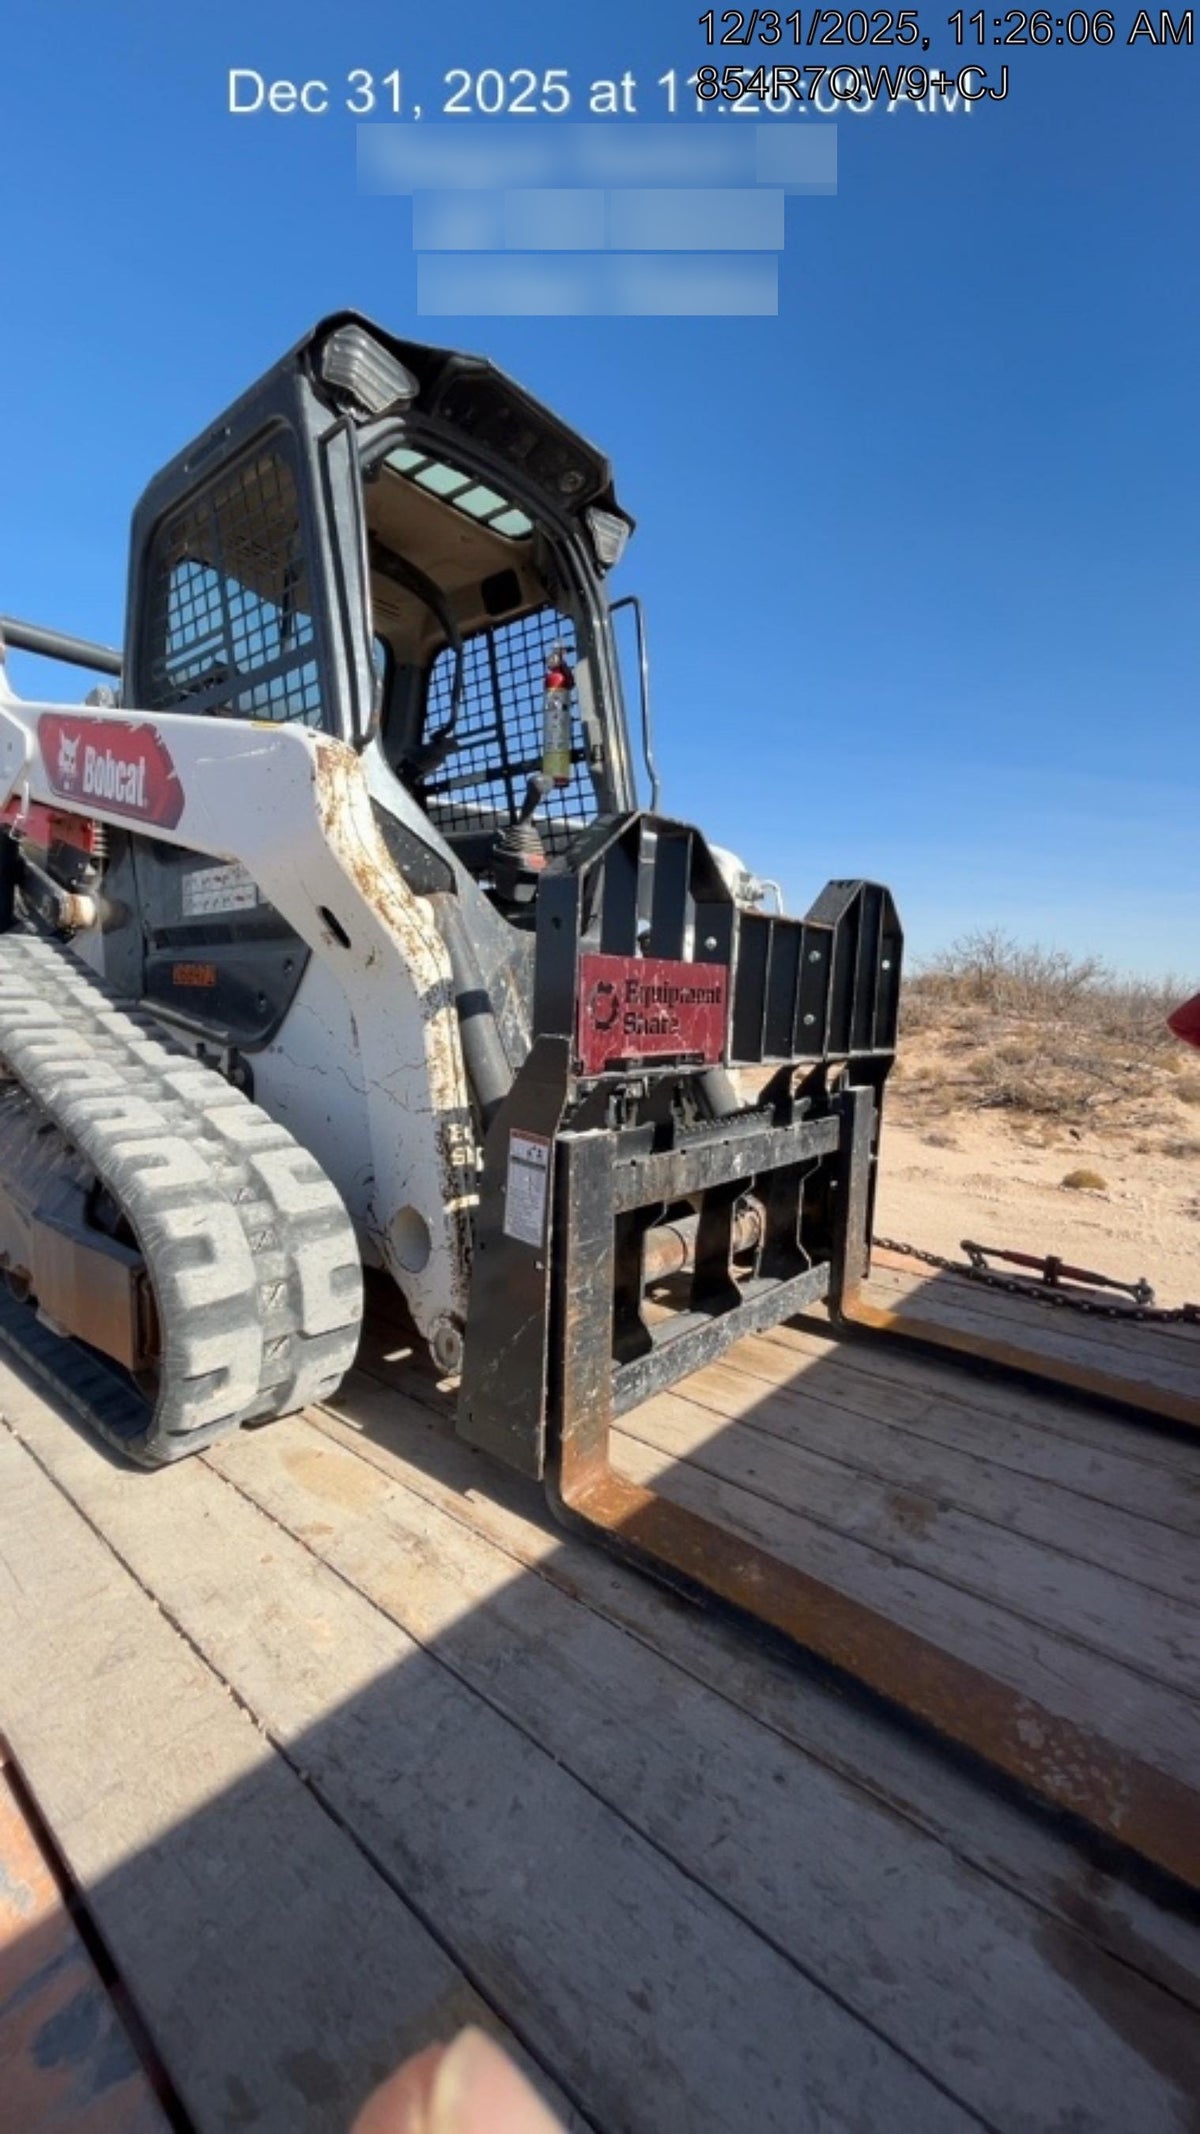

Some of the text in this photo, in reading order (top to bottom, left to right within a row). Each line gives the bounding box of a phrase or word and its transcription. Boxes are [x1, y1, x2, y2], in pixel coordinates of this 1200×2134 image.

[82, 745, 146, 806] Bobcat
[624, 979, 722, 1009] Equipment
[623, 1012, 679, 1035] Share
